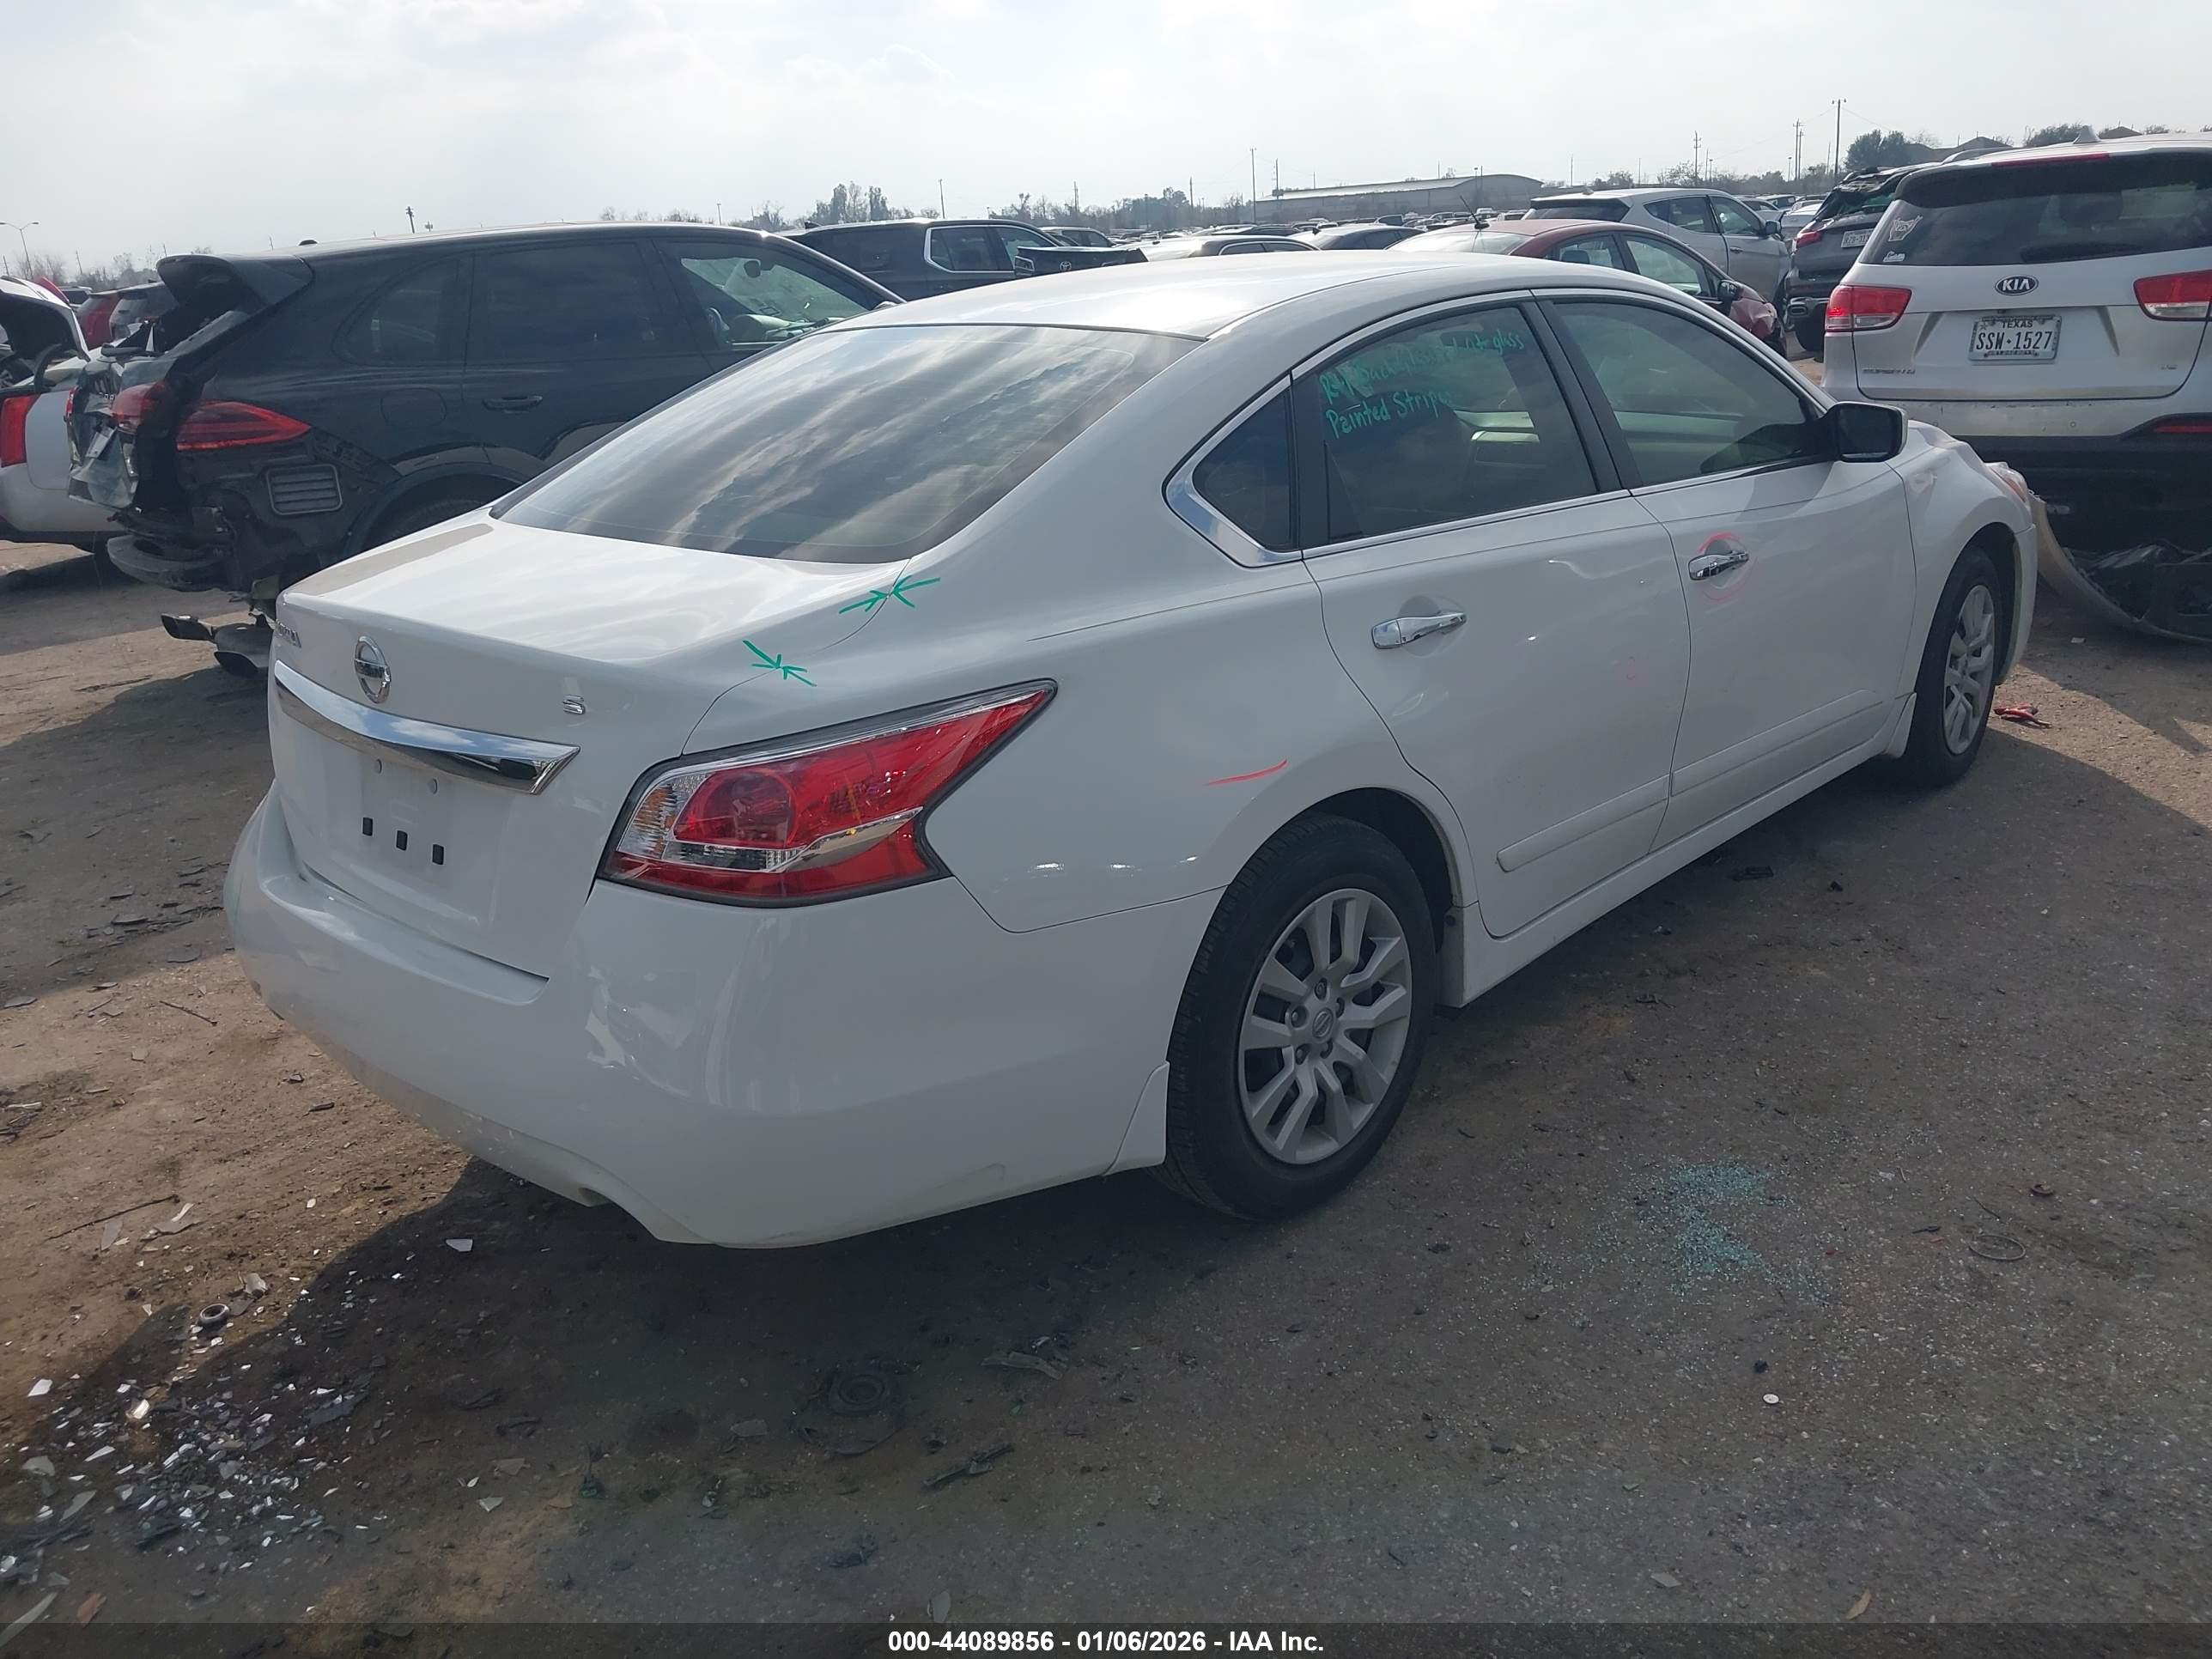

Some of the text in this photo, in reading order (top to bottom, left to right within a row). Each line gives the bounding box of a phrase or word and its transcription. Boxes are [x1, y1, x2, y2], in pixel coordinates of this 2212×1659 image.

[2002, 279, 2031, 291] KIA
[2001, 319, 2033, 329] TEXAS
[1325, 398, 1391, 440] Painted
[563, 695, 586, 714] S
